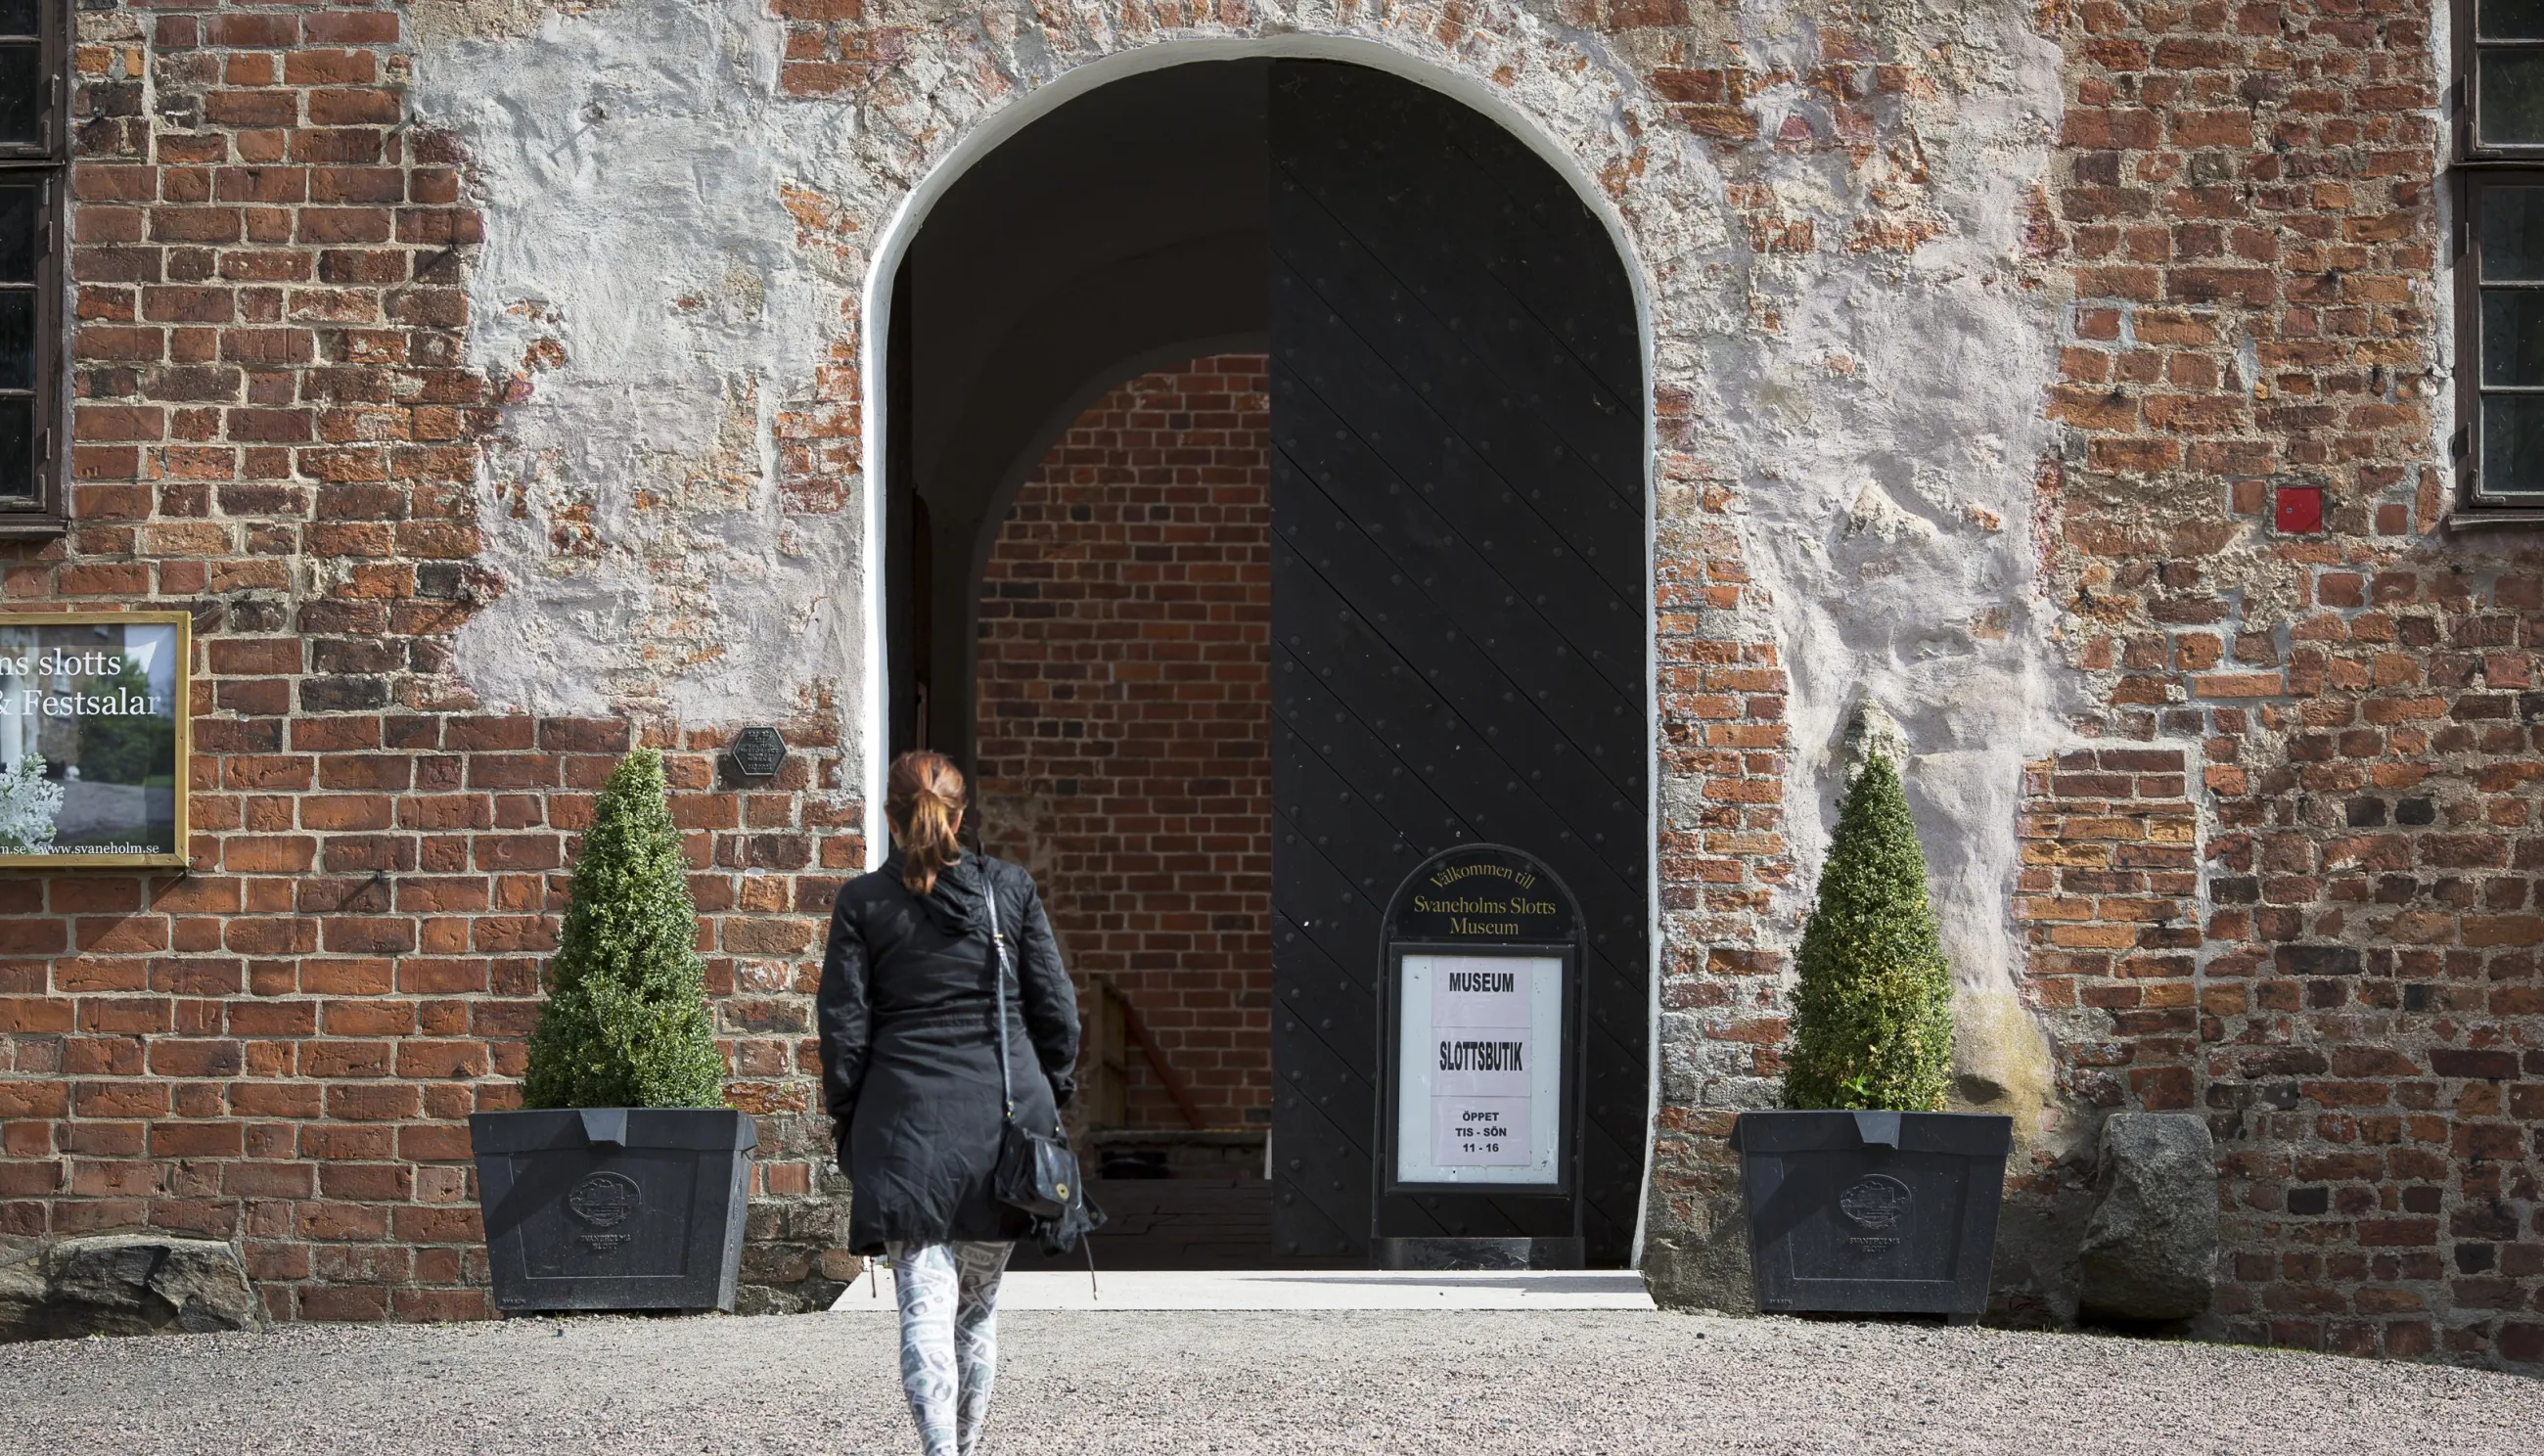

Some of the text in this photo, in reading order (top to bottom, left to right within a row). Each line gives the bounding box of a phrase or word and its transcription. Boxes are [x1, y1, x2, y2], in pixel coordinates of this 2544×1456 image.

[38, 647, 121, 676] slotts
[22, 687, 161, 716] Festsalar
[39, 842, 159, 854] www.svaneholm.se
[1430, 864, 1536, 890] Välkommen till
[1414, 895, 1556, 915] Svaneholms Slotts
[1450, 917, 1519, 935] Museum
[1449, 972, 1515, 993] MUSEUM
[1439, 1040, 1523, 1071] SLOTTSBUTIK
[1462, 1111, 1500, 1122] ÖPPET
[1455, 1127, 1474, 1138] TIS
[1482, 1125, 1508, 1138] SÖN
[1463, 1143, 1476, 1153] 11
[1485, 1143, 1500, 1153] 16
